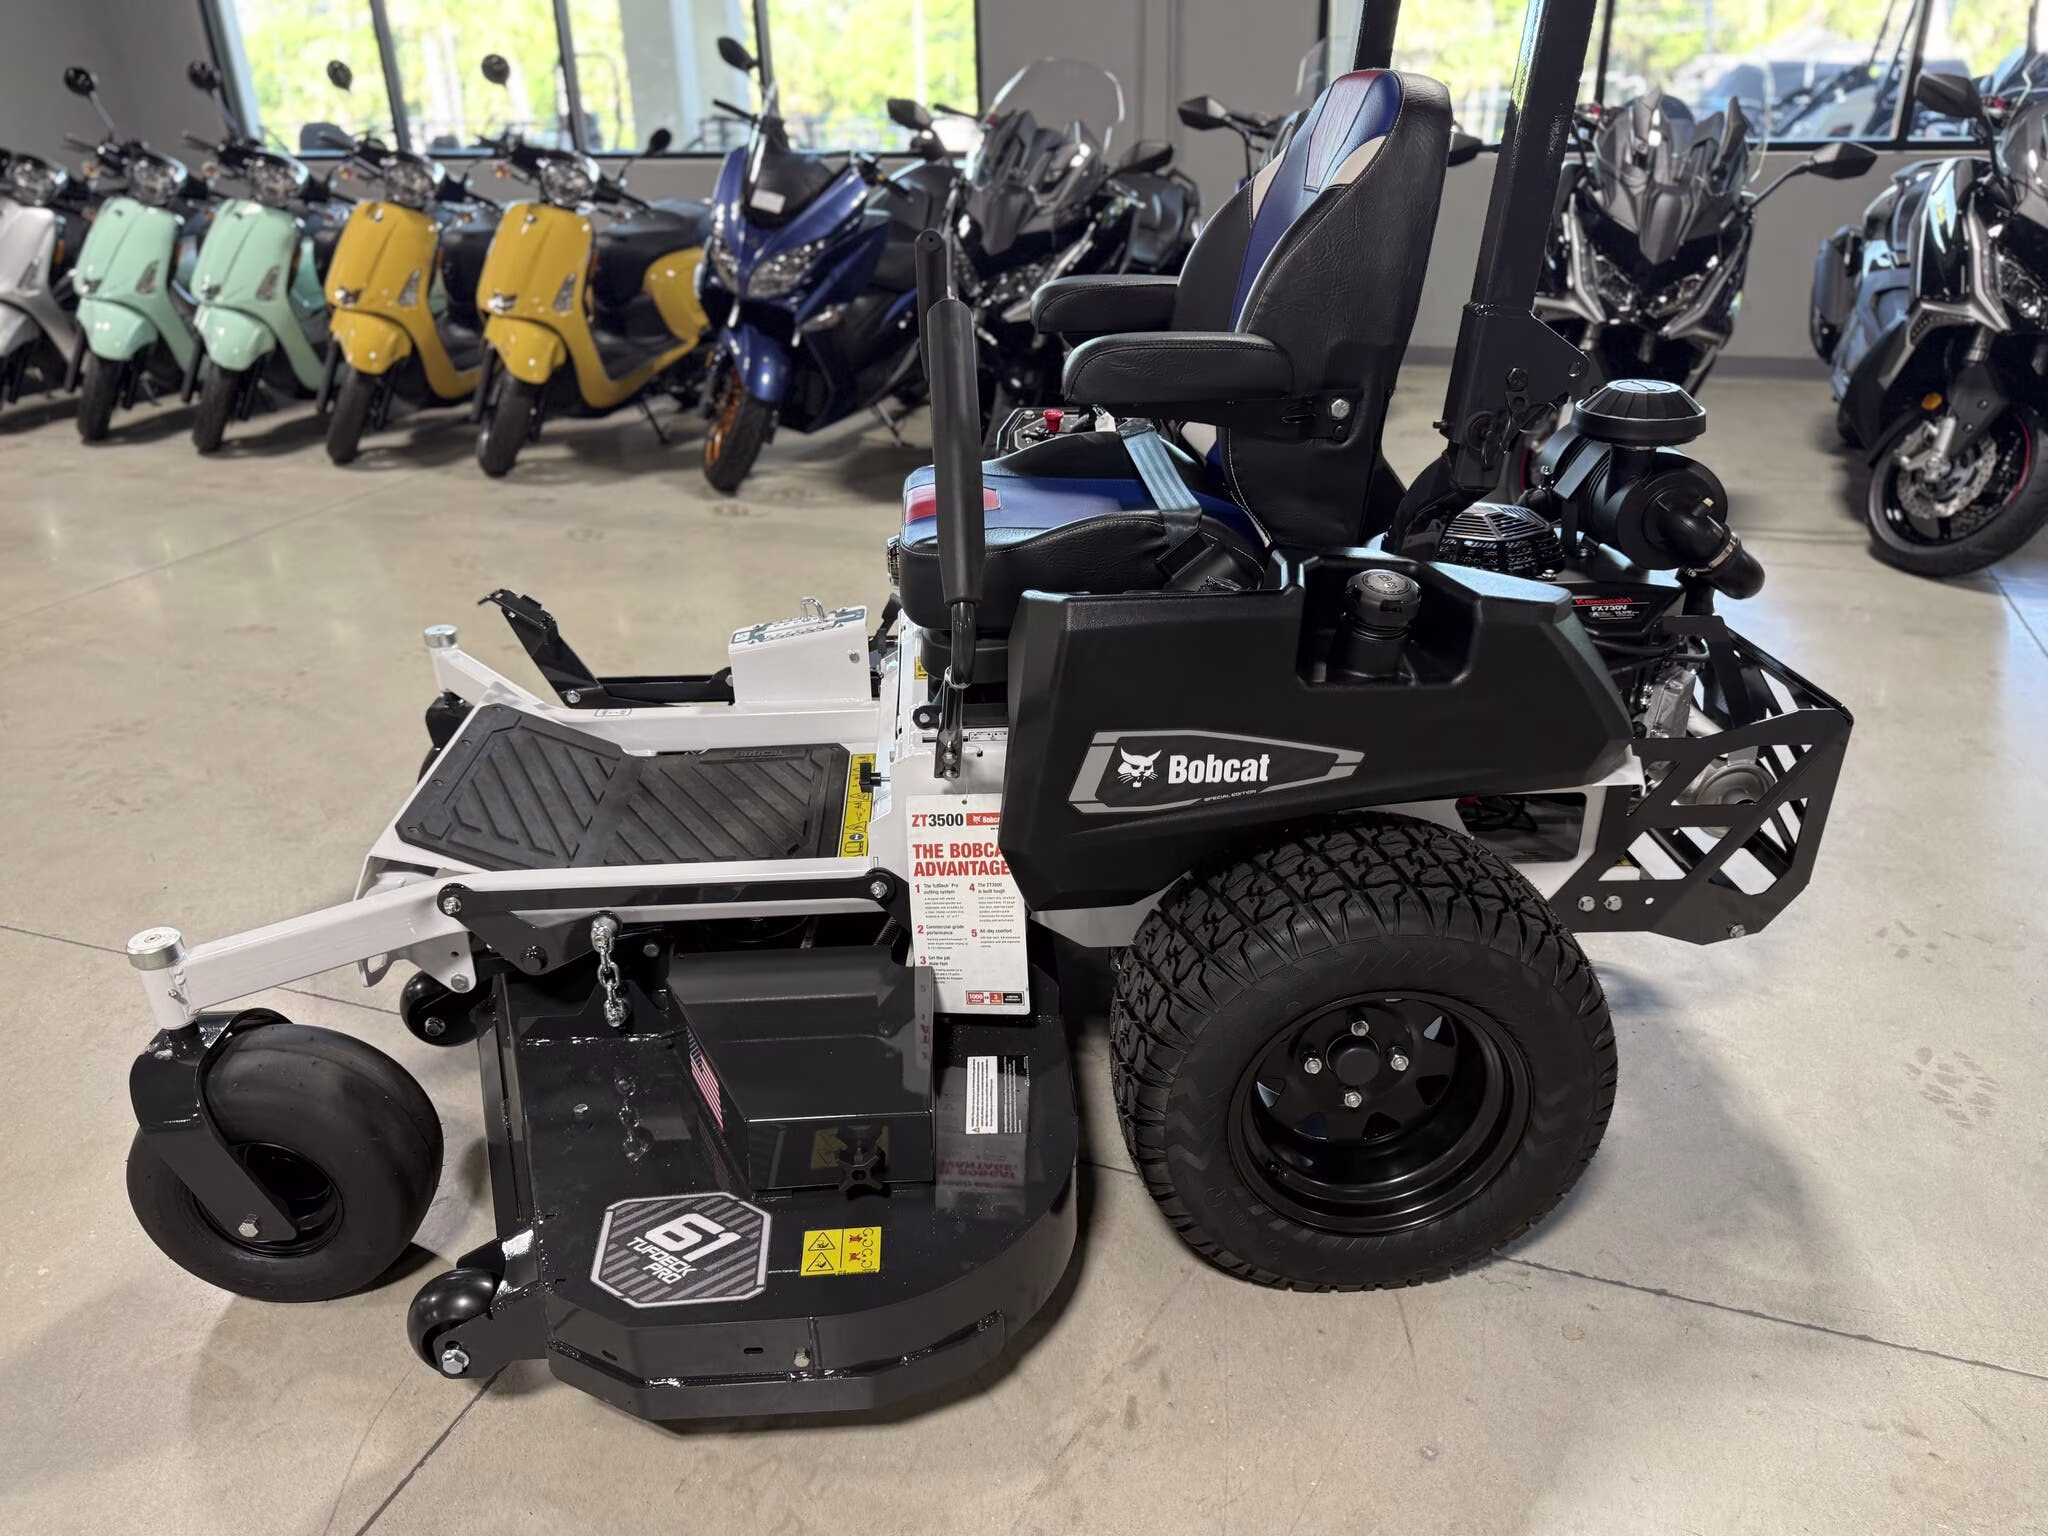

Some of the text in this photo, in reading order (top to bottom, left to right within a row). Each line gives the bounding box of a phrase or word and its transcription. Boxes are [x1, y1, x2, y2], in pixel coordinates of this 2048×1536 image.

[1575, 597, 1633, 605] Kawasaki
[1168, 754, 1270, 784] Bobcat
[912, 813, 964, 827] ZT3500
[982, 815, 1000, 824] Bobc
[912, 842, 1003, 859] THE BOBCA
[914, 861, 1010, 877] ADVANTAGE
[915, 883, 920, 893] 1
[969, 883, 976, 892] 4
[917, 925, 924, 935] 2
[971, 929, 977, 938] 5
[920, 956, 926, 965] 3
[645, 1213, 741, 1262] 61
[627, 1236, 698, 1277] TUFDECK
[643, 1262, 682, 1285] PRO
